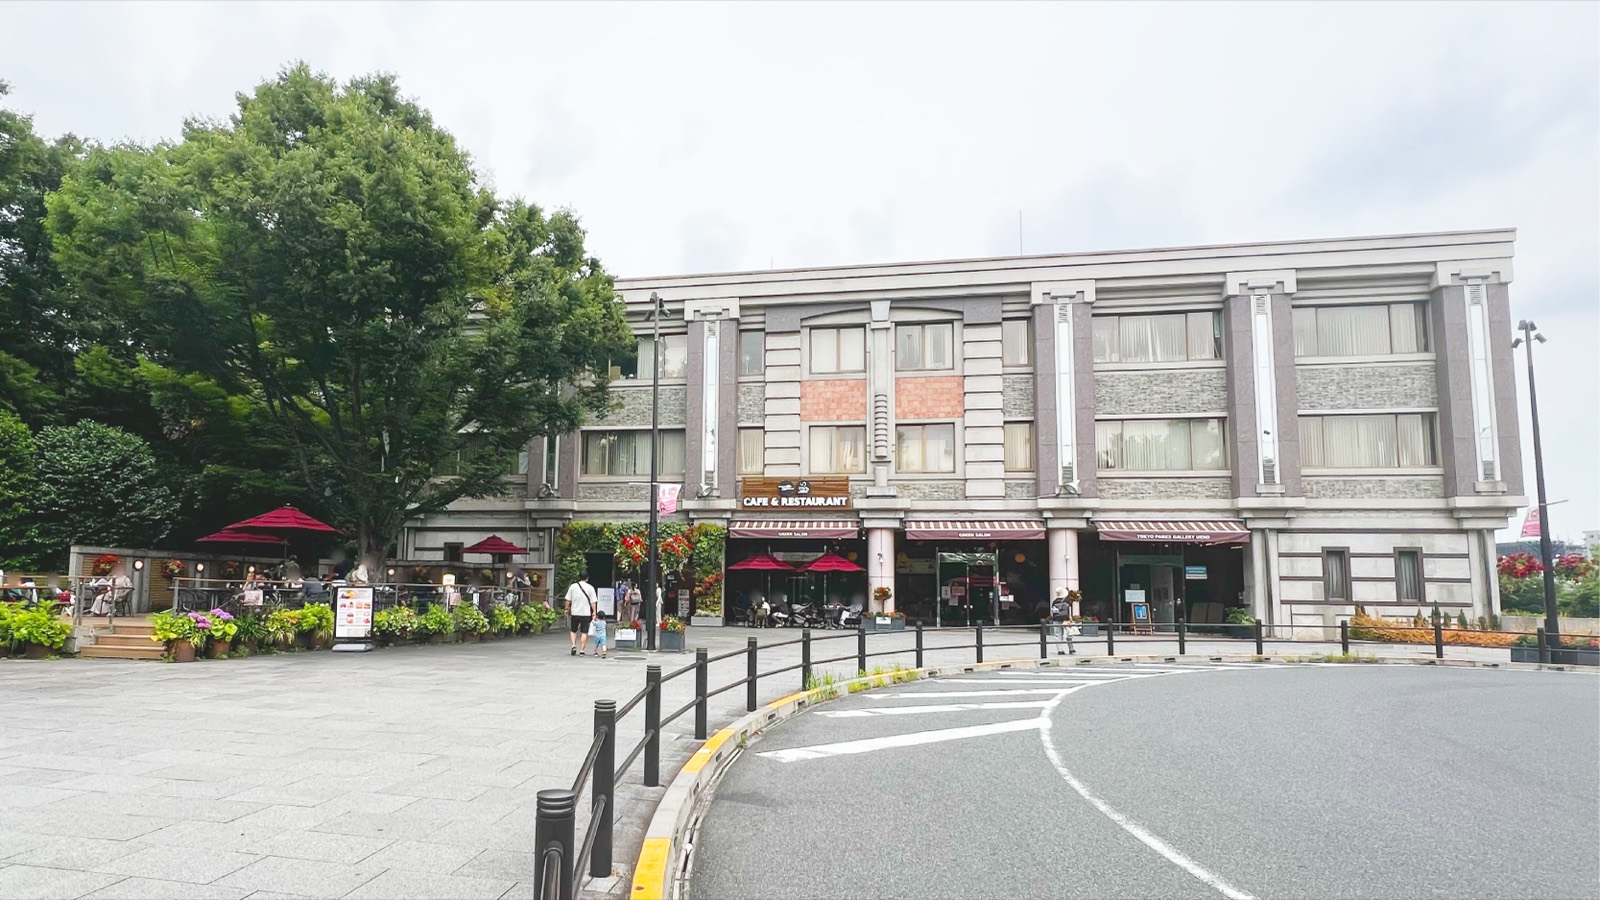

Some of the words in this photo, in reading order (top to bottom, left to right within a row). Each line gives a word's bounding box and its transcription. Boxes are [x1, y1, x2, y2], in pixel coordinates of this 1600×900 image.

[743, 497, 769, 506] CAFE
[771, 497, 779, 506] &
[781, 497, 847, 506] RESTAURANT
